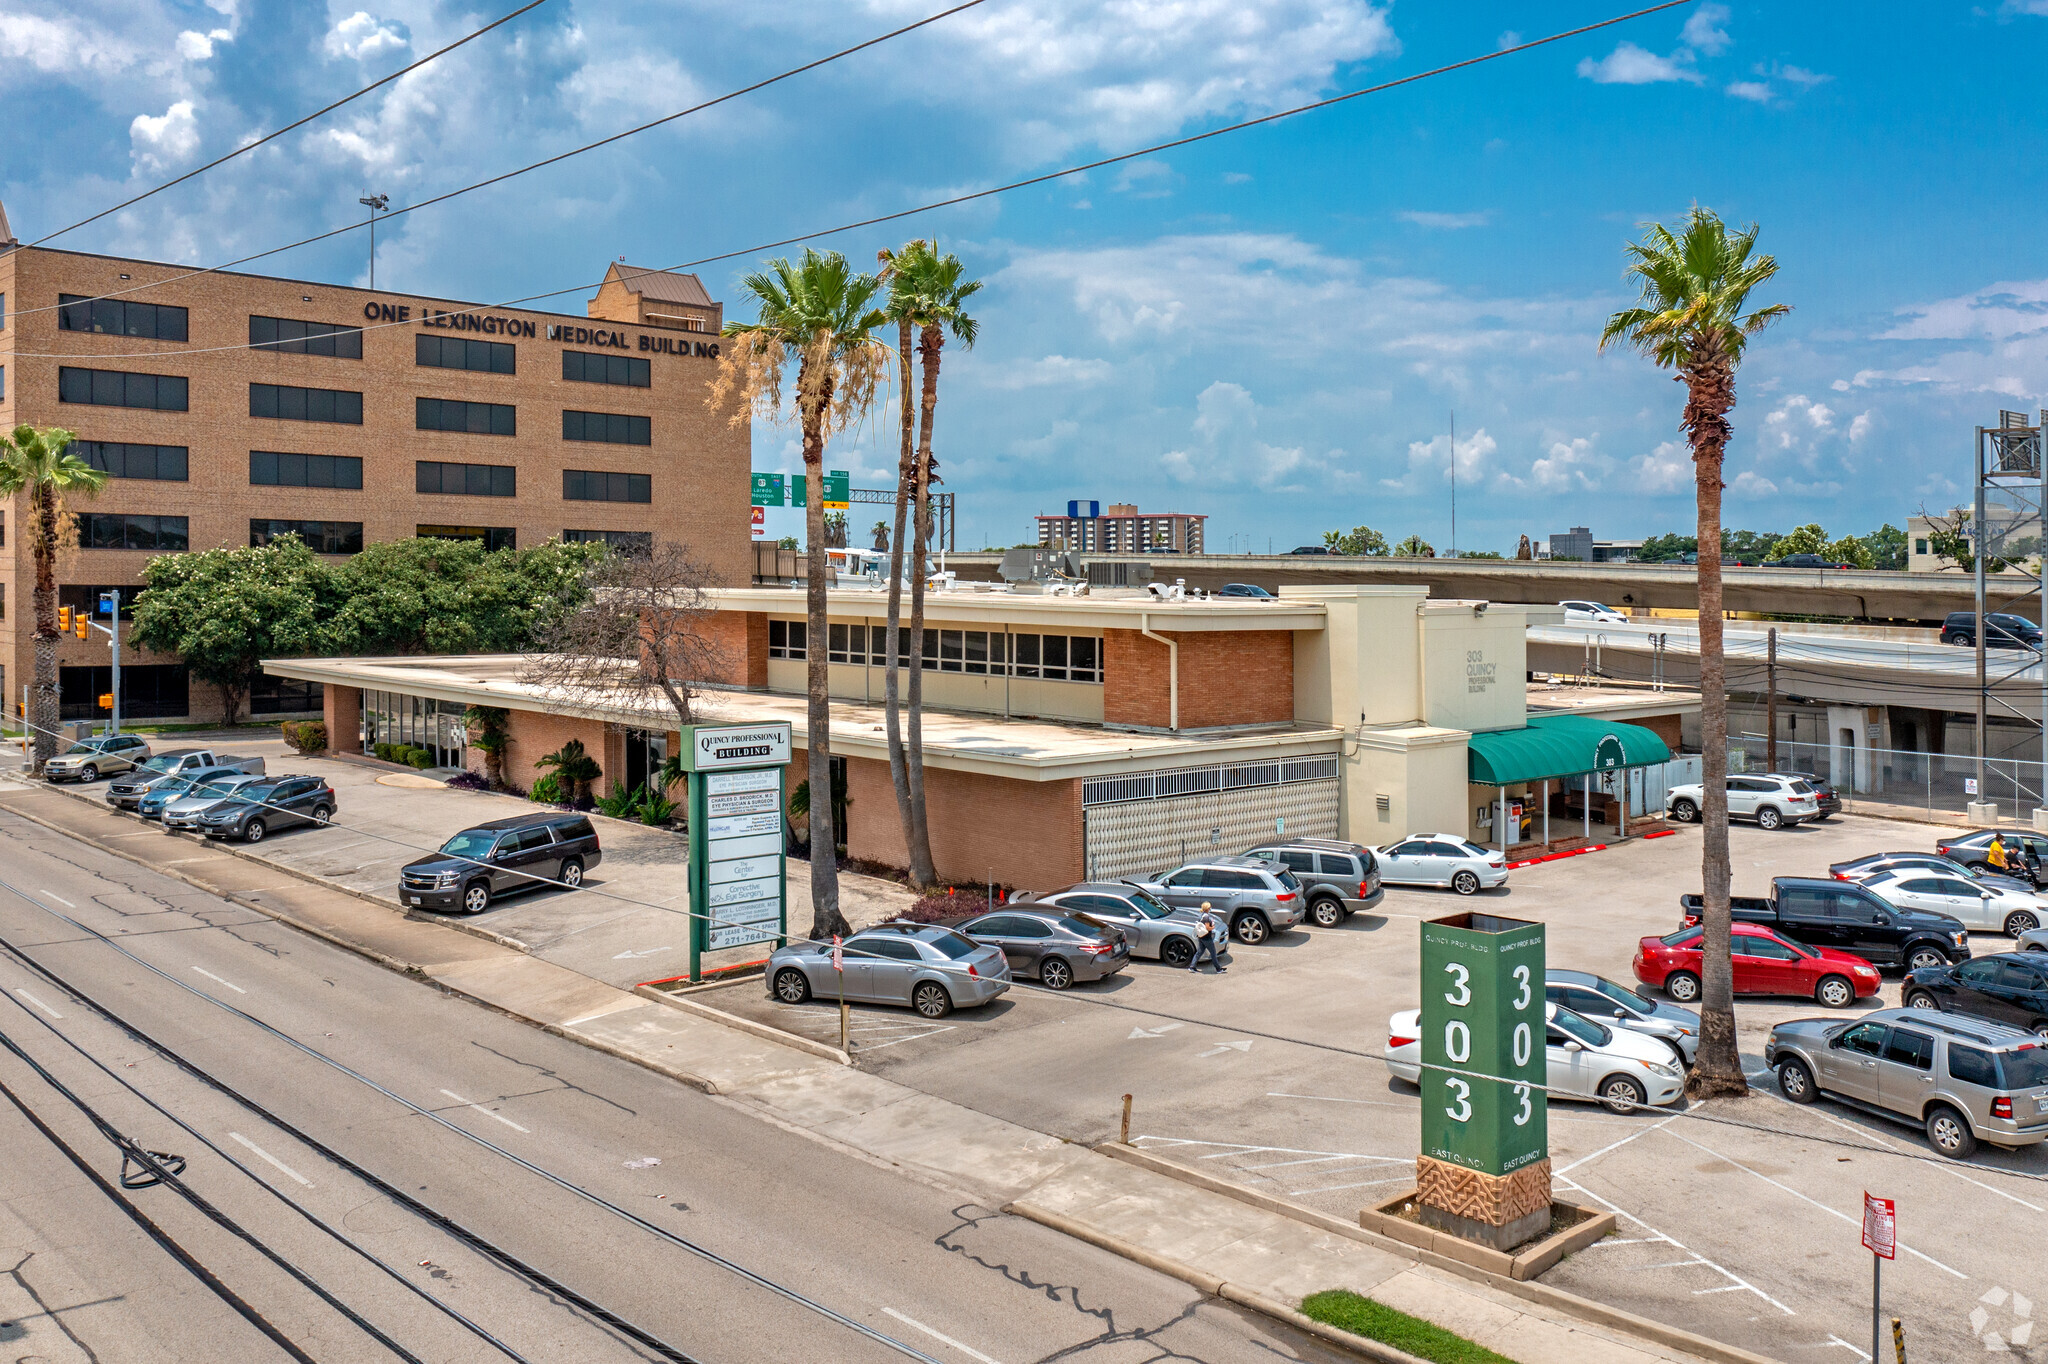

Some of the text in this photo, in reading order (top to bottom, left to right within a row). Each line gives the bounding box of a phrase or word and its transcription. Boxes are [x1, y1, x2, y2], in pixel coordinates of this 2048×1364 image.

[364, 302, 720, 359] ONE LEXINGTON MEDICAL BUILDING
[1467, 650, 1482, 662] 303
[1467, 663, 1496, 676] QUINCY
[701, 732, 784, 752] QUINCY PROFESSIONAL
[719, 746, 768, 758] BUILDING
[1606, 758, 1614, 766] 303
[734, 866, 754, 874] Center
[730, 884, 760, 893] Corrective
[739, 890, 764, 898] Surgery
[725, 933, 766, 944] 271-7648
[1426, 934, 1448, 944] QUINCY
[1500, 943, 1516, 952] QUINCY
[1530, 937, 1542, 946] BLDG
[1432, 1147, 1484, 1168] EAST QUINCY
[1504, 1149, 1540, 1170] EAST QUINCY
